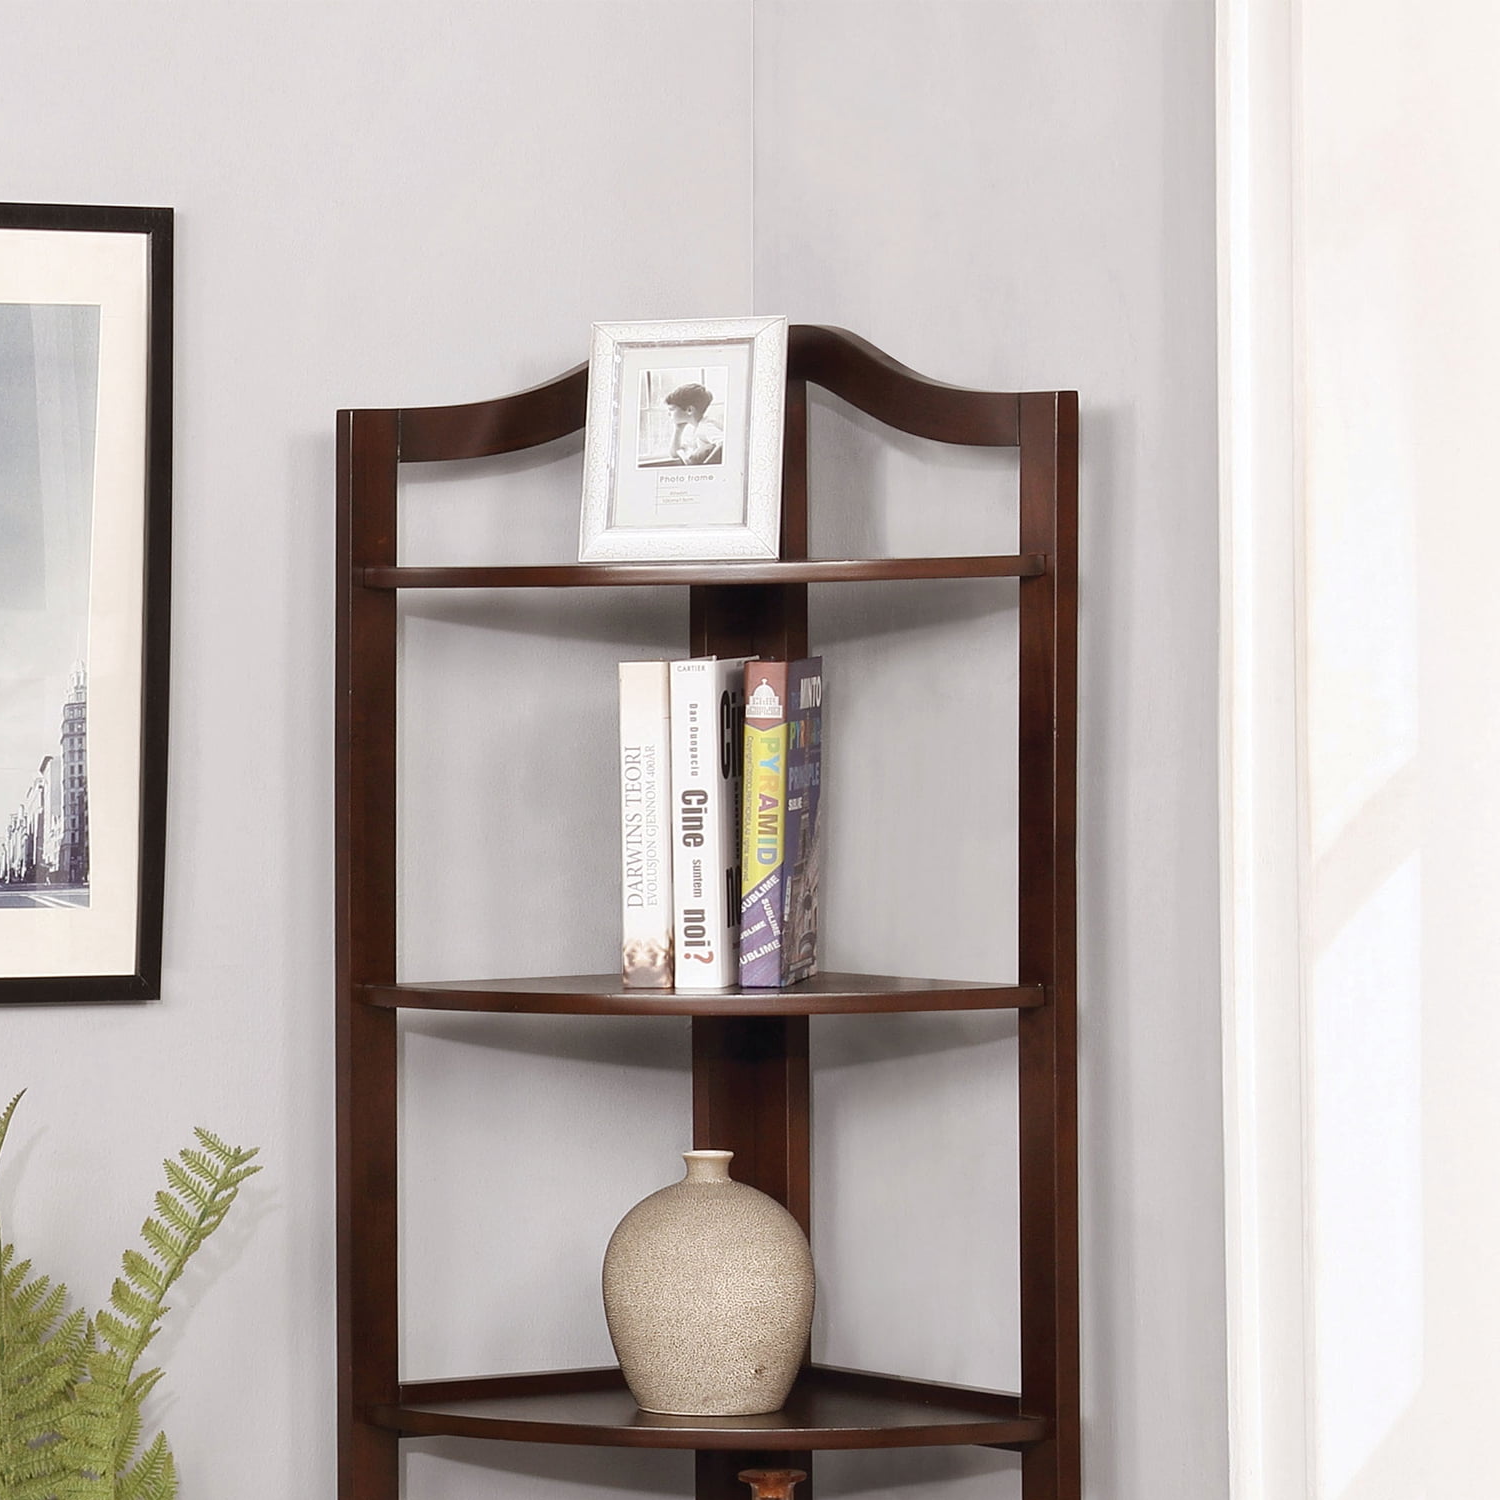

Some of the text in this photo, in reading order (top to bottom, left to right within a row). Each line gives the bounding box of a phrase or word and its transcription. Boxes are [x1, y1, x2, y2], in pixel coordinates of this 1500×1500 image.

[659, 473, 714, 484] Photo frame
[676, 665, 706, 673] CARTIER
[688, 703, 699, 723] Dan
[645, 780, 659, 837] GJENNOM
[756, 736, 781, 865] PYRAMID
[623, 745, 643, 909] DARWINS TEORI
[646, 840, 661, 906] EVOLUSJON
[681, 789, 714, 964] Cine suntem noi?
[761, 898, 781, 937] SUBLIME
[739, 939, 782, 965] UBLIME
